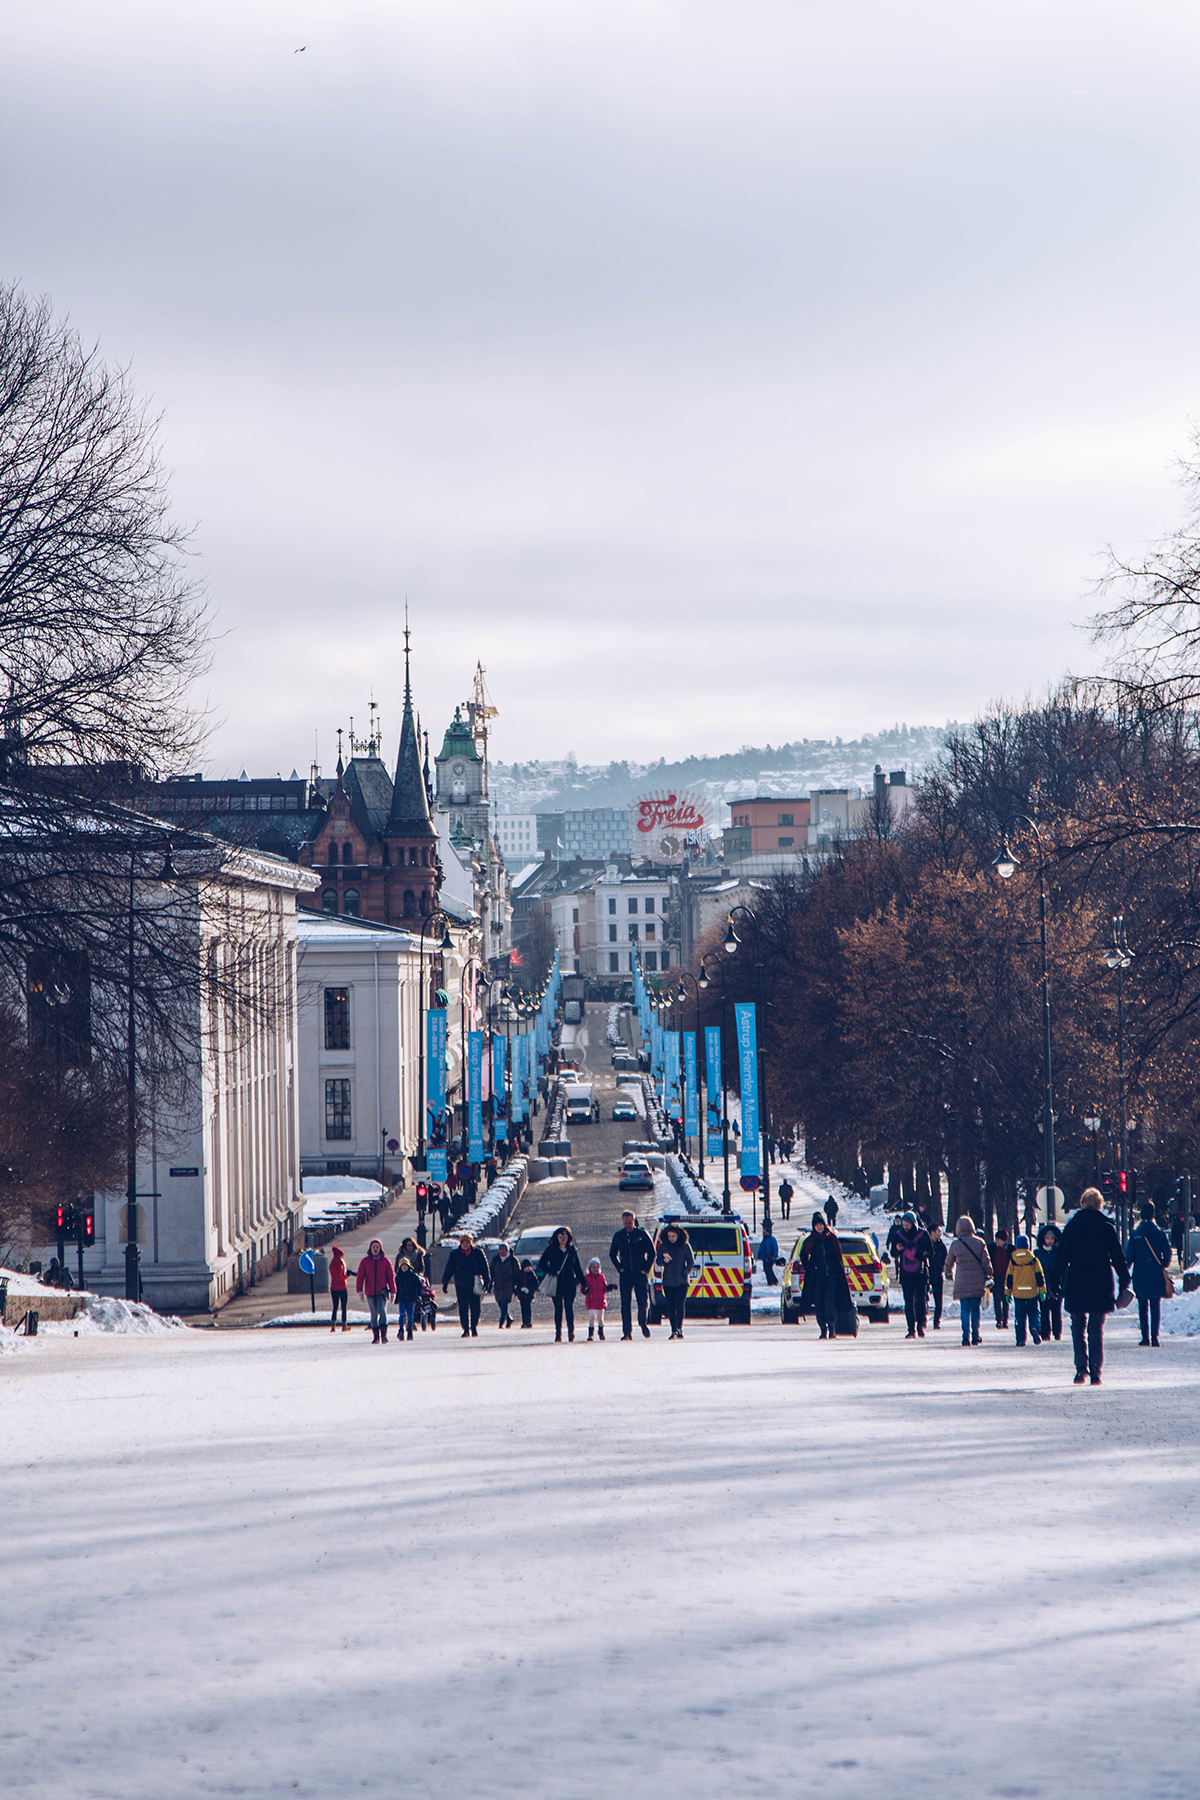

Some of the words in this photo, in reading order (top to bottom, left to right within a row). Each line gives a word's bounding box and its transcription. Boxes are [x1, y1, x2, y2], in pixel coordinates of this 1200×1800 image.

[637, 795, 704, 833] Freia
[740, 1010, 752, 1048] Astrup
[470, 1036, 480, 1065] Astrup
[471, 1067, 481, 1102] Fearnley
[741, 1050, 754, 1097] Fearnley
[472, 1104, 480, 1136] Museet
[744, 1099, 756, 1141] Museet
[742, 1146, 758, 1154] AFM
